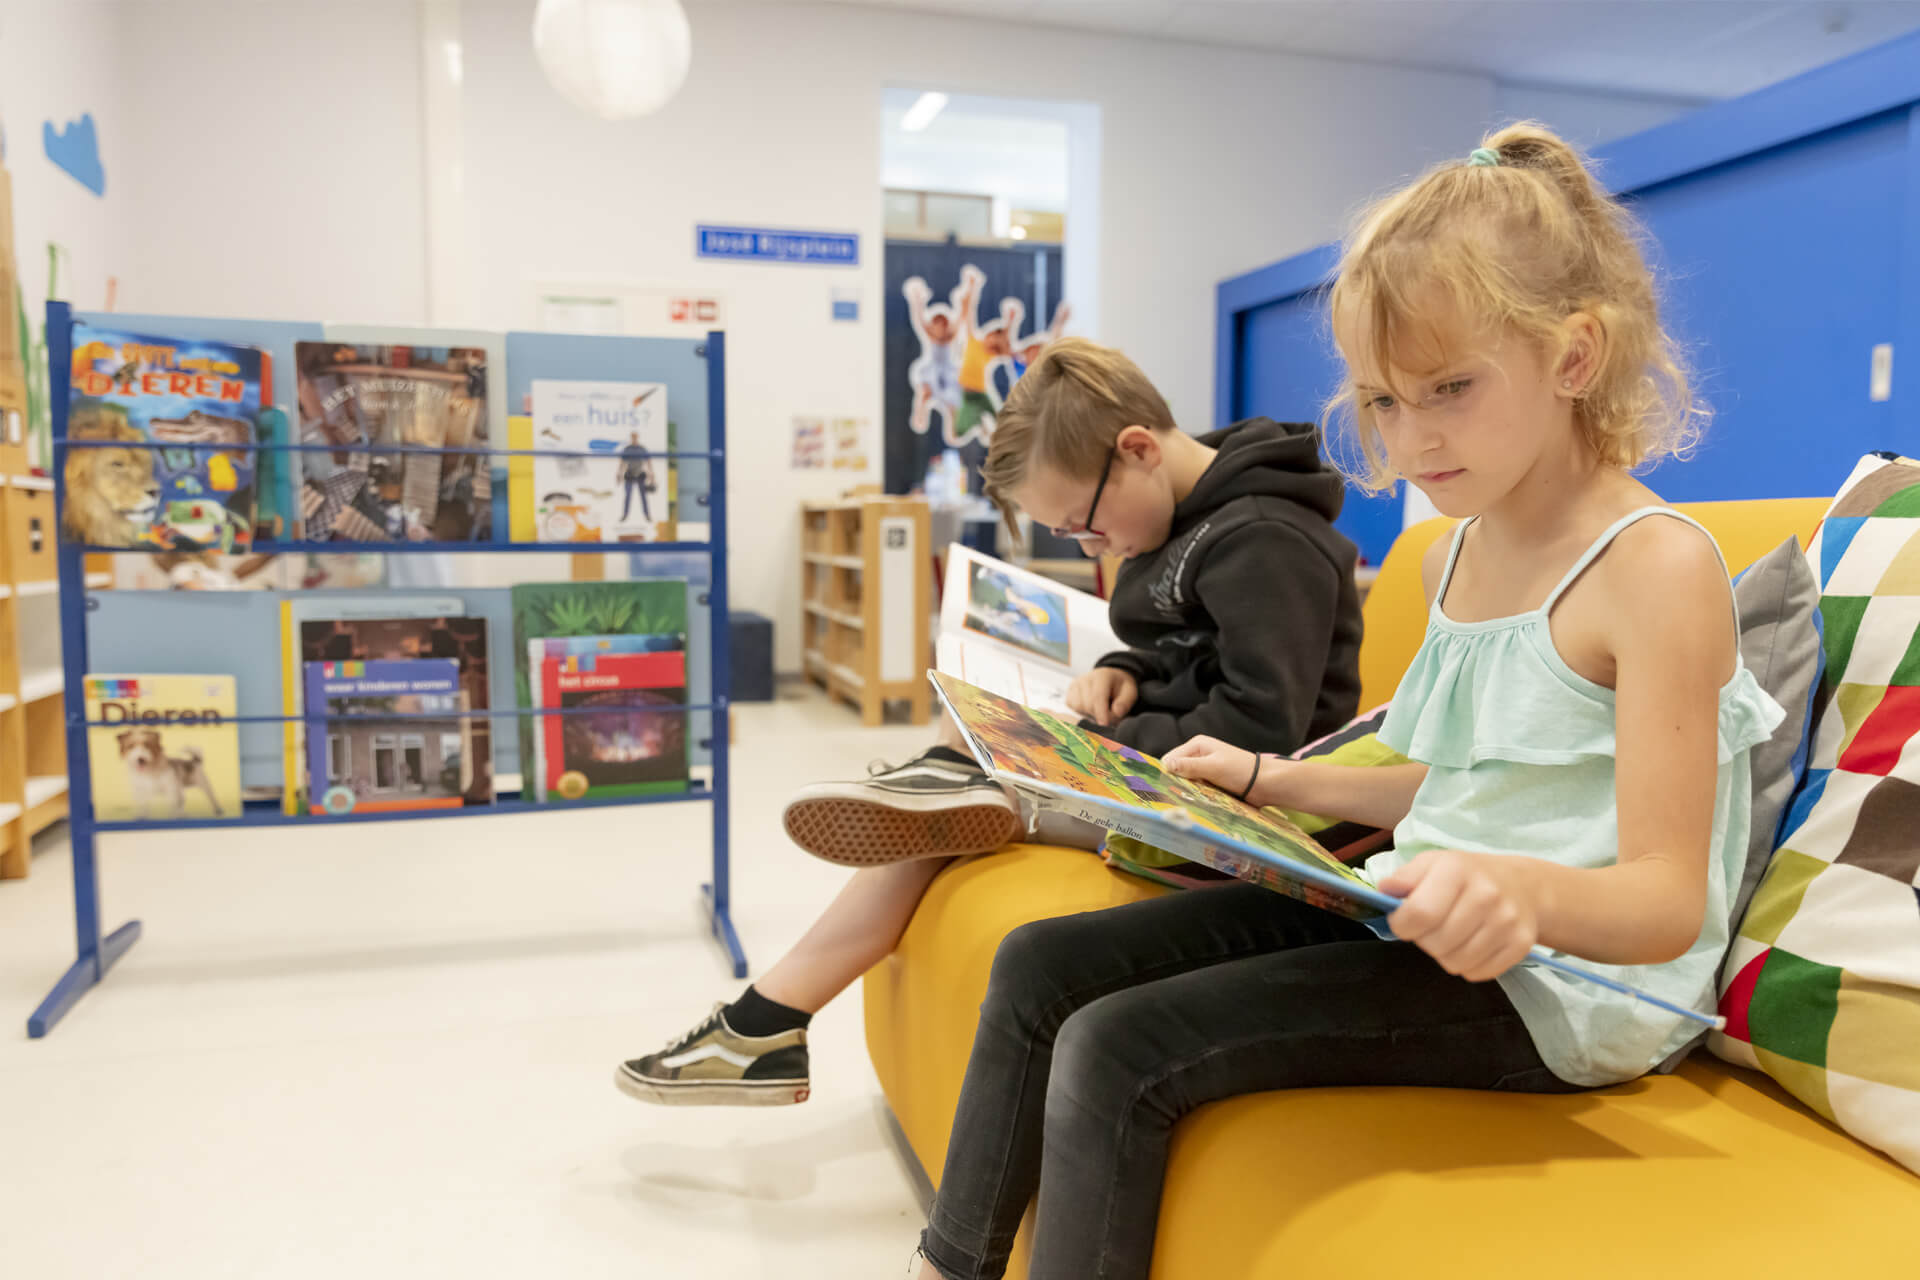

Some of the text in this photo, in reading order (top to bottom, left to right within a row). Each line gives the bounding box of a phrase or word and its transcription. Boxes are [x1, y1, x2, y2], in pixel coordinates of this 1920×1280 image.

[87, 372, 245, 402] DIEREN
[100, 702, 223, 728] Dieren
[1079, 809, 1144, 840] De gele ballon
